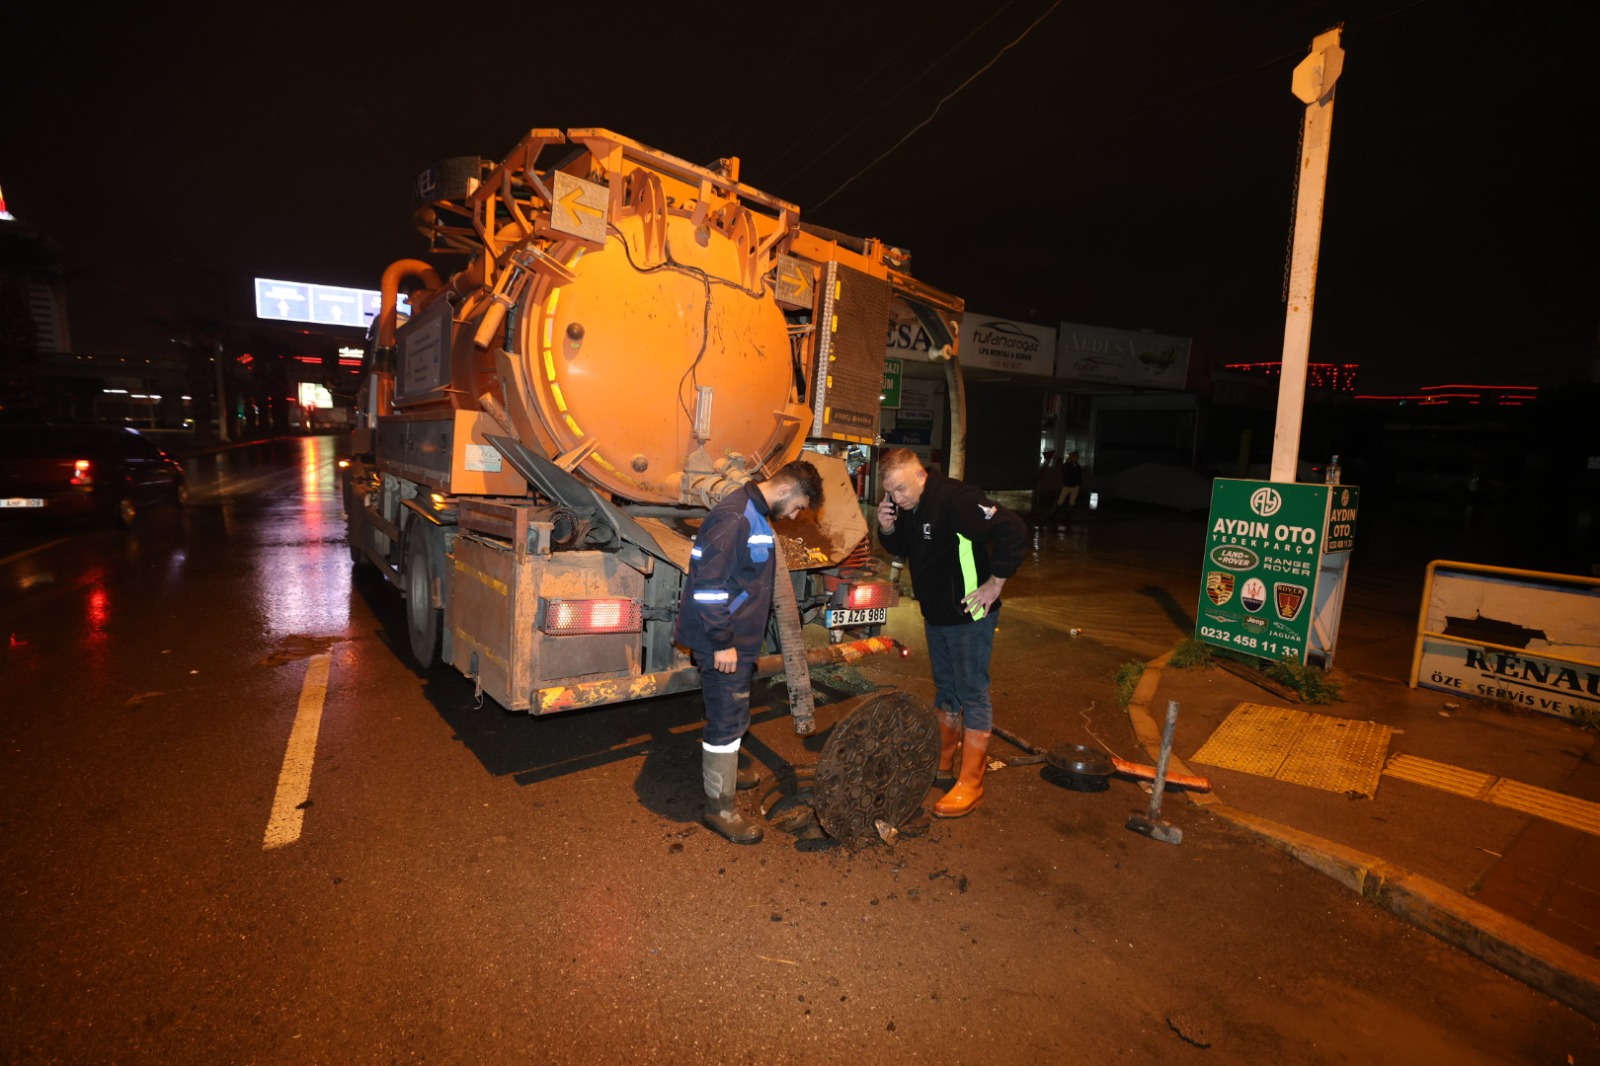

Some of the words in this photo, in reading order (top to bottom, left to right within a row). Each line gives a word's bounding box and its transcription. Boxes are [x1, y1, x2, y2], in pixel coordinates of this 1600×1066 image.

[1330, 509, 1356, 522] AYDIN
[1213, 518, 1269, 539] AYDIN
[1274, 524, 1316, 545] OTO
[1333, 524, 1350, 538] OTO
[1213, 534, 1257, 547] YEDEK
[1263, 541, 1314, 555] PARÇA
[1264, 556, 1311, 569] RANGE
[1263, 564, 1311, 577] ROVER
[1278, 585, 1304, 594] ROVER
[832, 611, 845, 624] 35
[847, 610, 865, 623] AZG
[868, 608, 885, 621] 988
[1246, 616, 1265, 627] Jeep
[1200, 626, 1230, 641] 0232
[1233, 635, 1258, 648] 458
[1261, 641, 1277, 653] 11
[1282, 646, 1299, 657] 33
[1269, 630, 1301, 642] JAGUAR
[1540, 698, 1562, 712] VE
